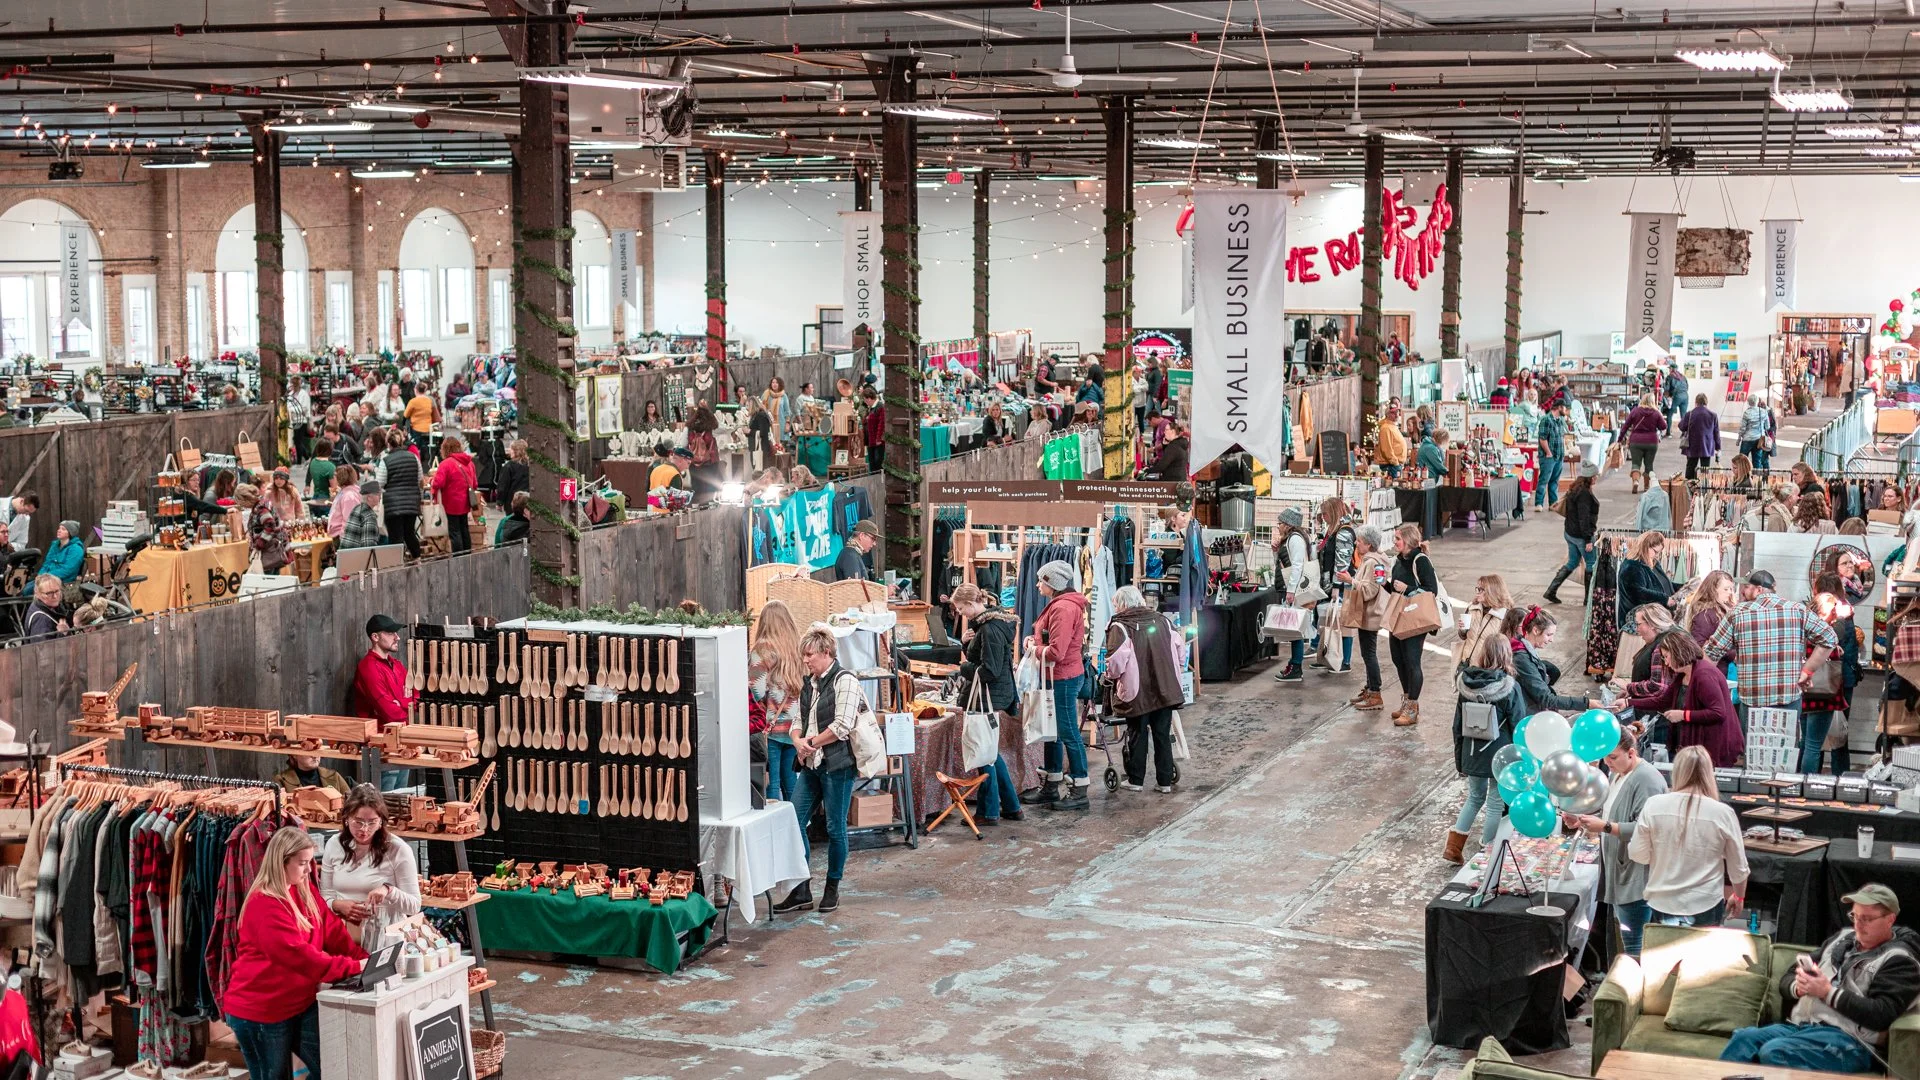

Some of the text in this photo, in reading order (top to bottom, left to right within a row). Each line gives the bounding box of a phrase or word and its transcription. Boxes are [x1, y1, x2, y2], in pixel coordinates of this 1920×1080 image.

[69, 232, 80, 313] EXPERIENCE
[620, 232, 628, 271] BUSINESS
[857, 226, 870, 319] SHOP SMALL
[1642, 218, 1661, 334] SUPPORT LOCAL
[1775, 228, 1787, 297] EXPERIENCE
[1226, 203, 1250, 433] SMALL BUSINESS
[942, 486, 960, 494] help
[1077, 485, 1117, 493] protecting
[208, 568, 248, 598] be
[430, 1054, 453, 1069] BOUTIQUE
